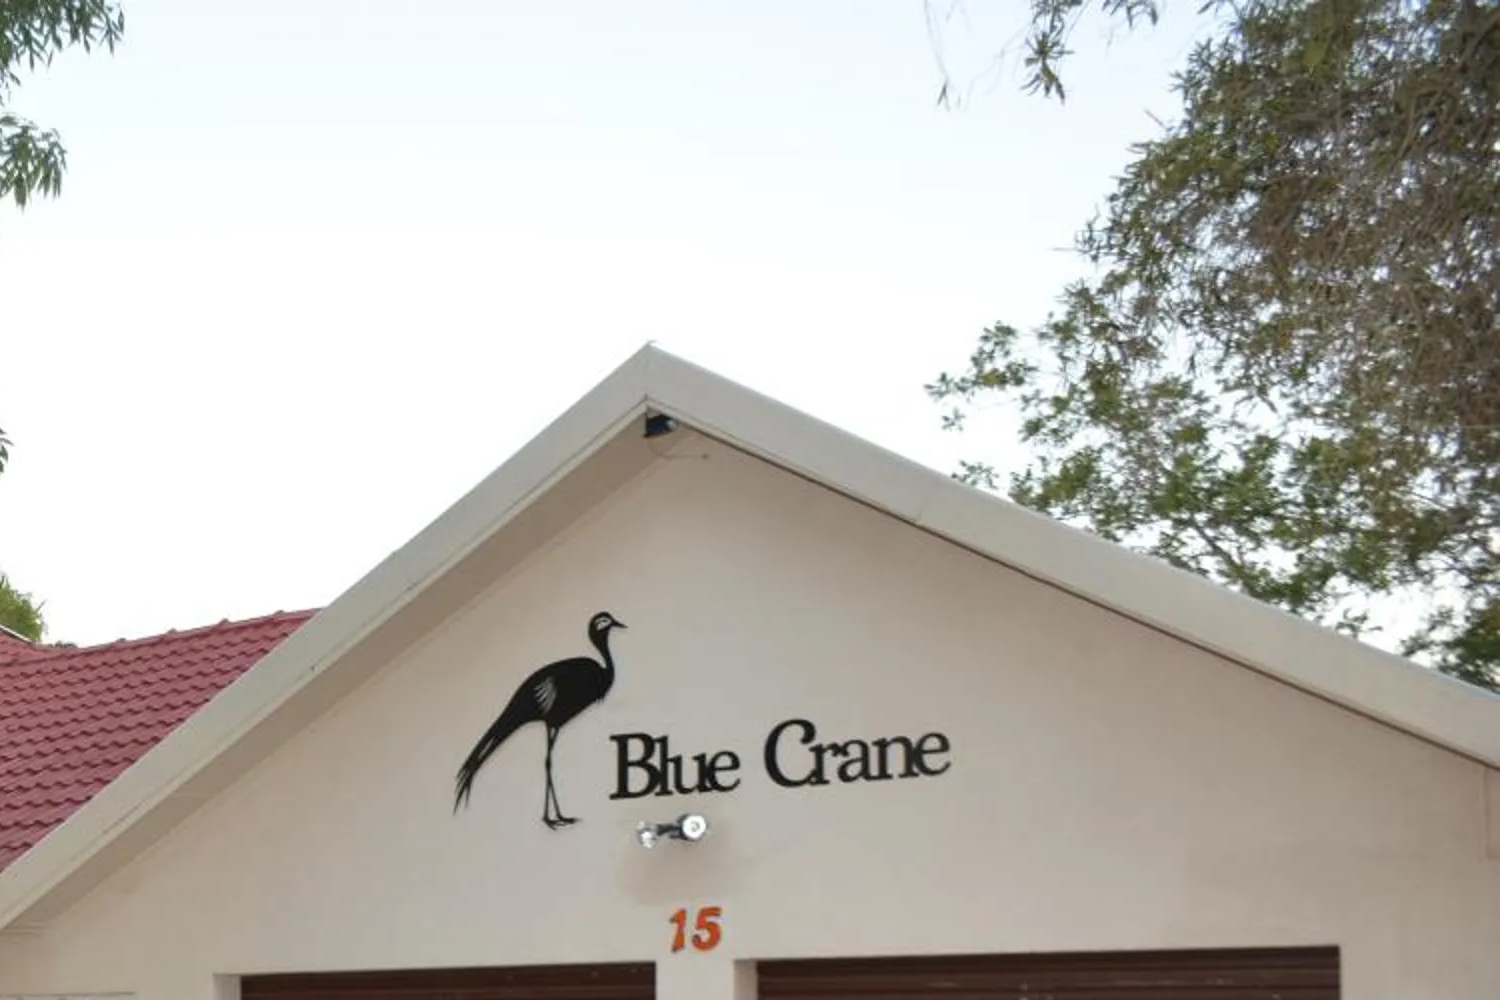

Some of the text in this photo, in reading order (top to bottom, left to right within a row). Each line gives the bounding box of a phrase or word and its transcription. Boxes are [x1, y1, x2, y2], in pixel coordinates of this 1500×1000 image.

[609, 719, 951, 800] Blue Crane
[669, 906, 722, 953] 15
